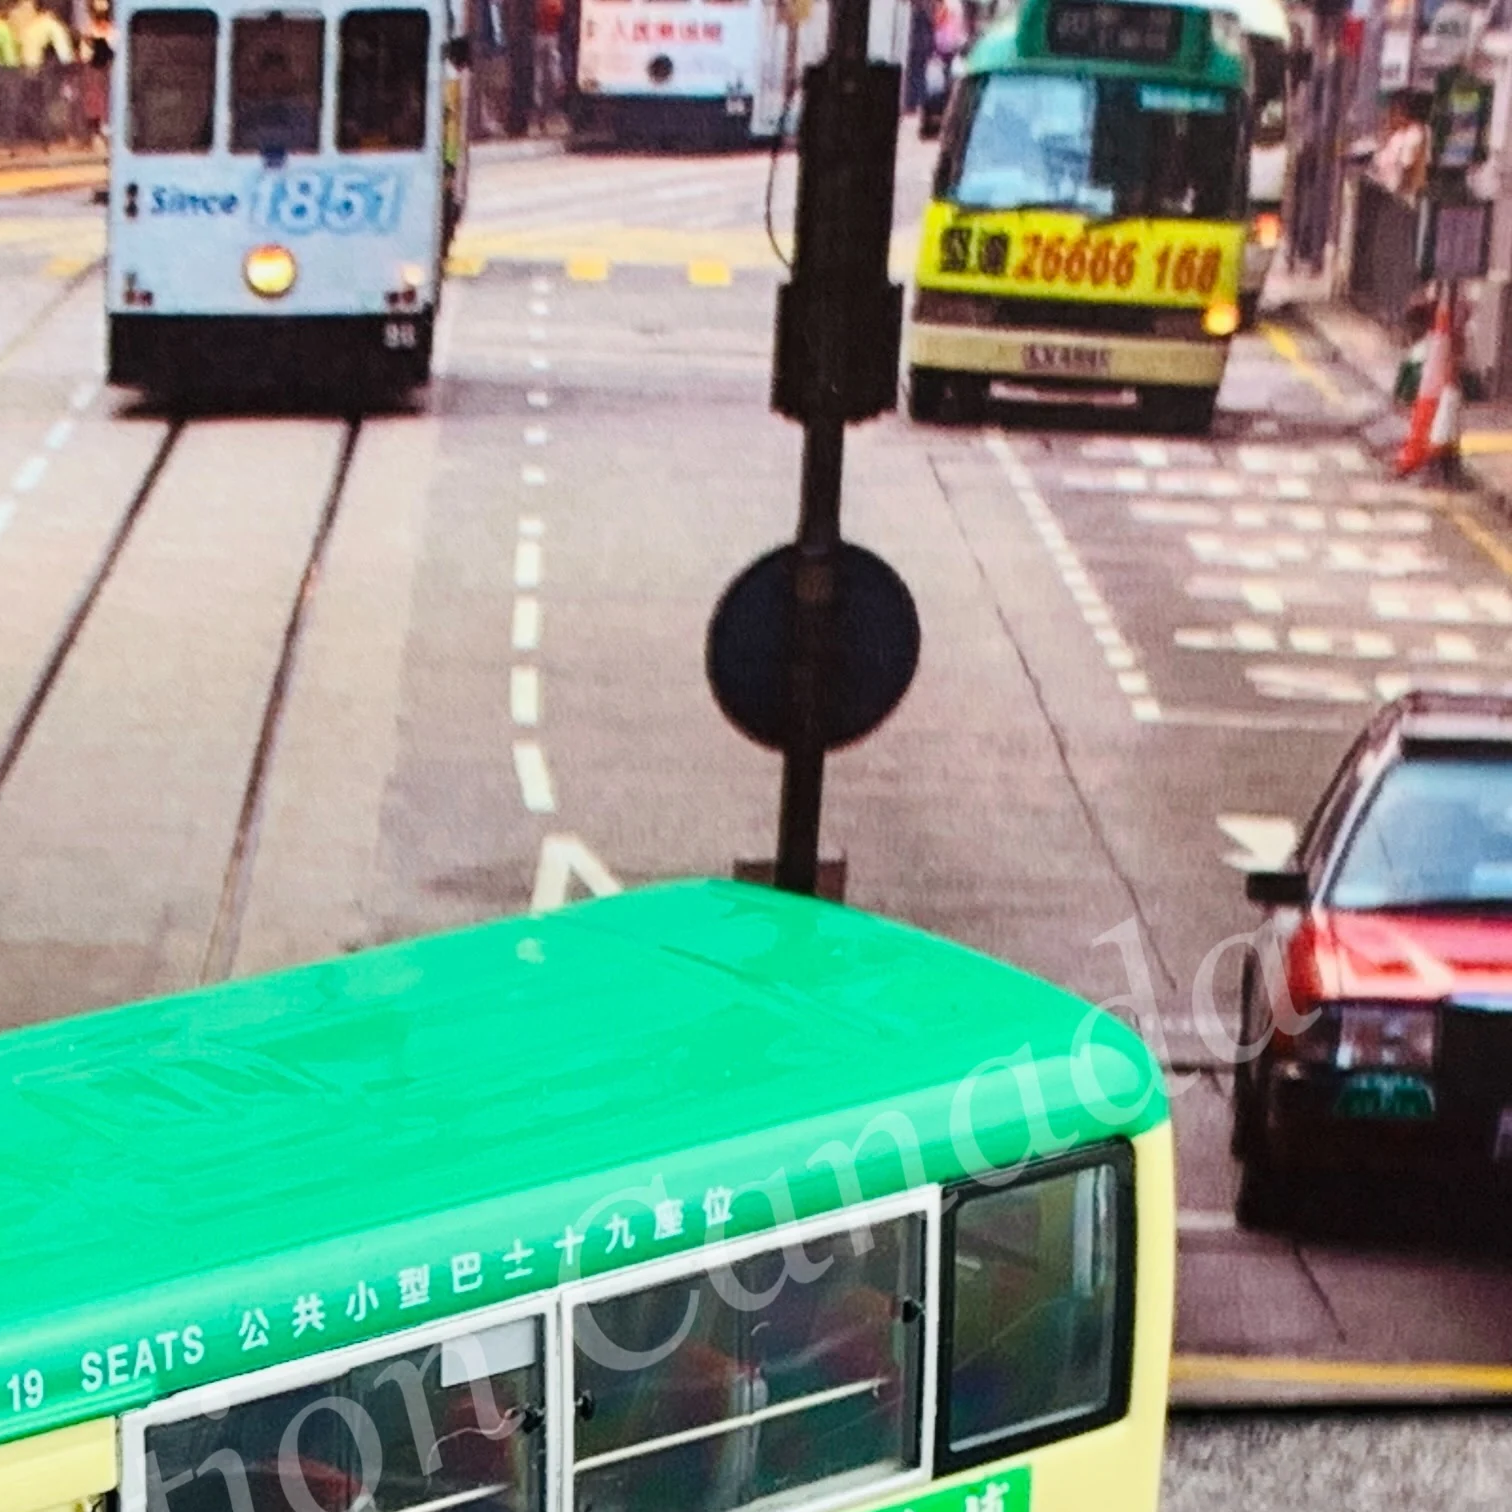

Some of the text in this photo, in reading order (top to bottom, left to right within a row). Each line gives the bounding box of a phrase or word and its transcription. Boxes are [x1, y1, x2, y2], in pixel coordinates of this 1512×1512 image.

[150, 169, 403, 235] Since 1851
[1013, 231, 1140, 289] 26666
[238, 1184, 735, 1352] 公共小型巴士十九座位
[7, 1369, 44, 1411] 19
[81, 1326, 205, 1393] SEATS
